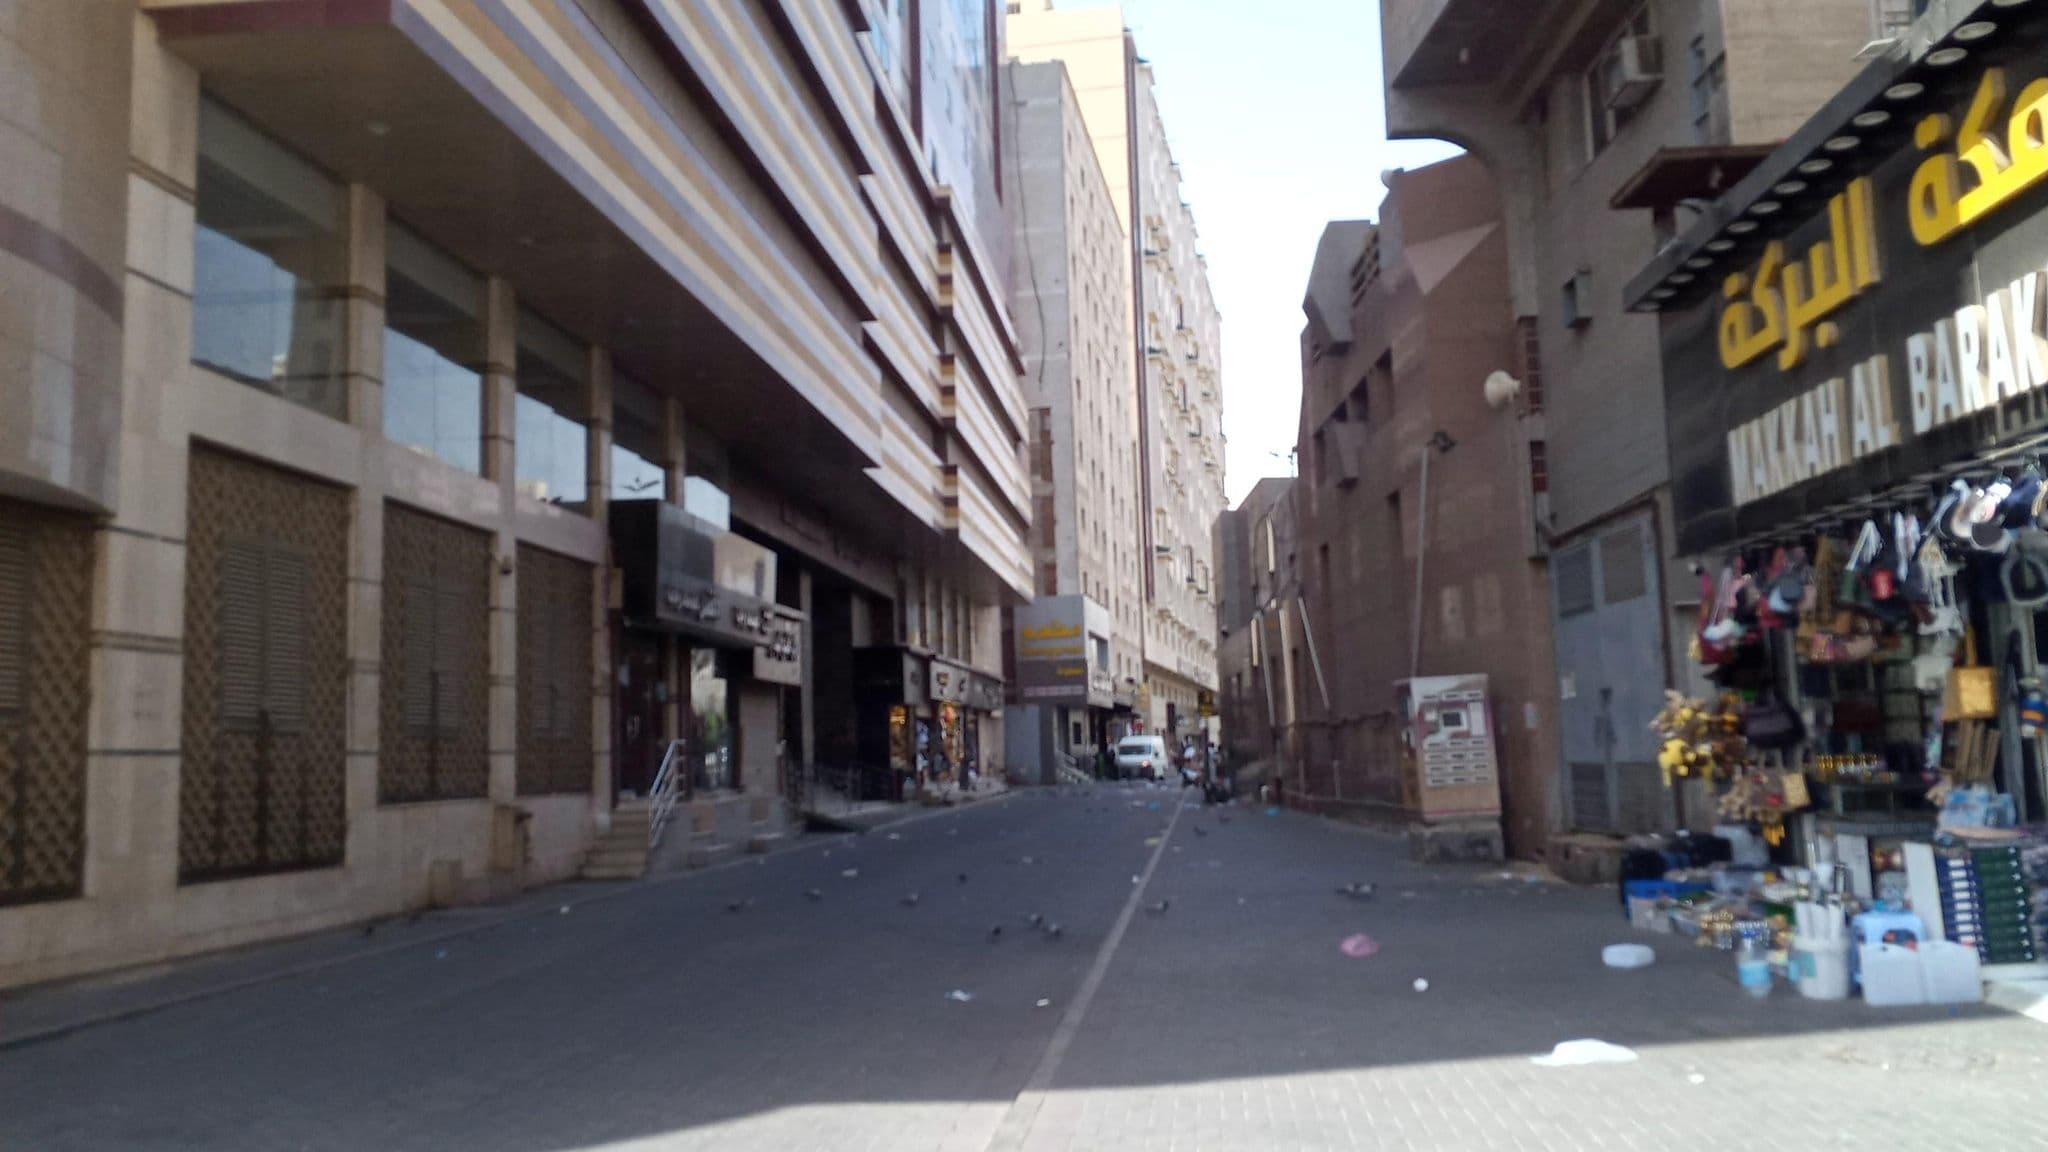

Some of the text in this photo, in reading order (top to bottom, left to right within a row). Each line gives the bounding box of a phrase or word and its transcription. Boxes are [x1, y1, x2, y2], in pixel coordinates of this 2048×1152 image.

[1719, 66, 2048, 371] مكة البركة
[1727, 377, 1848, 507] MAKKAH
[1851, 354, 1898, 458] AL
